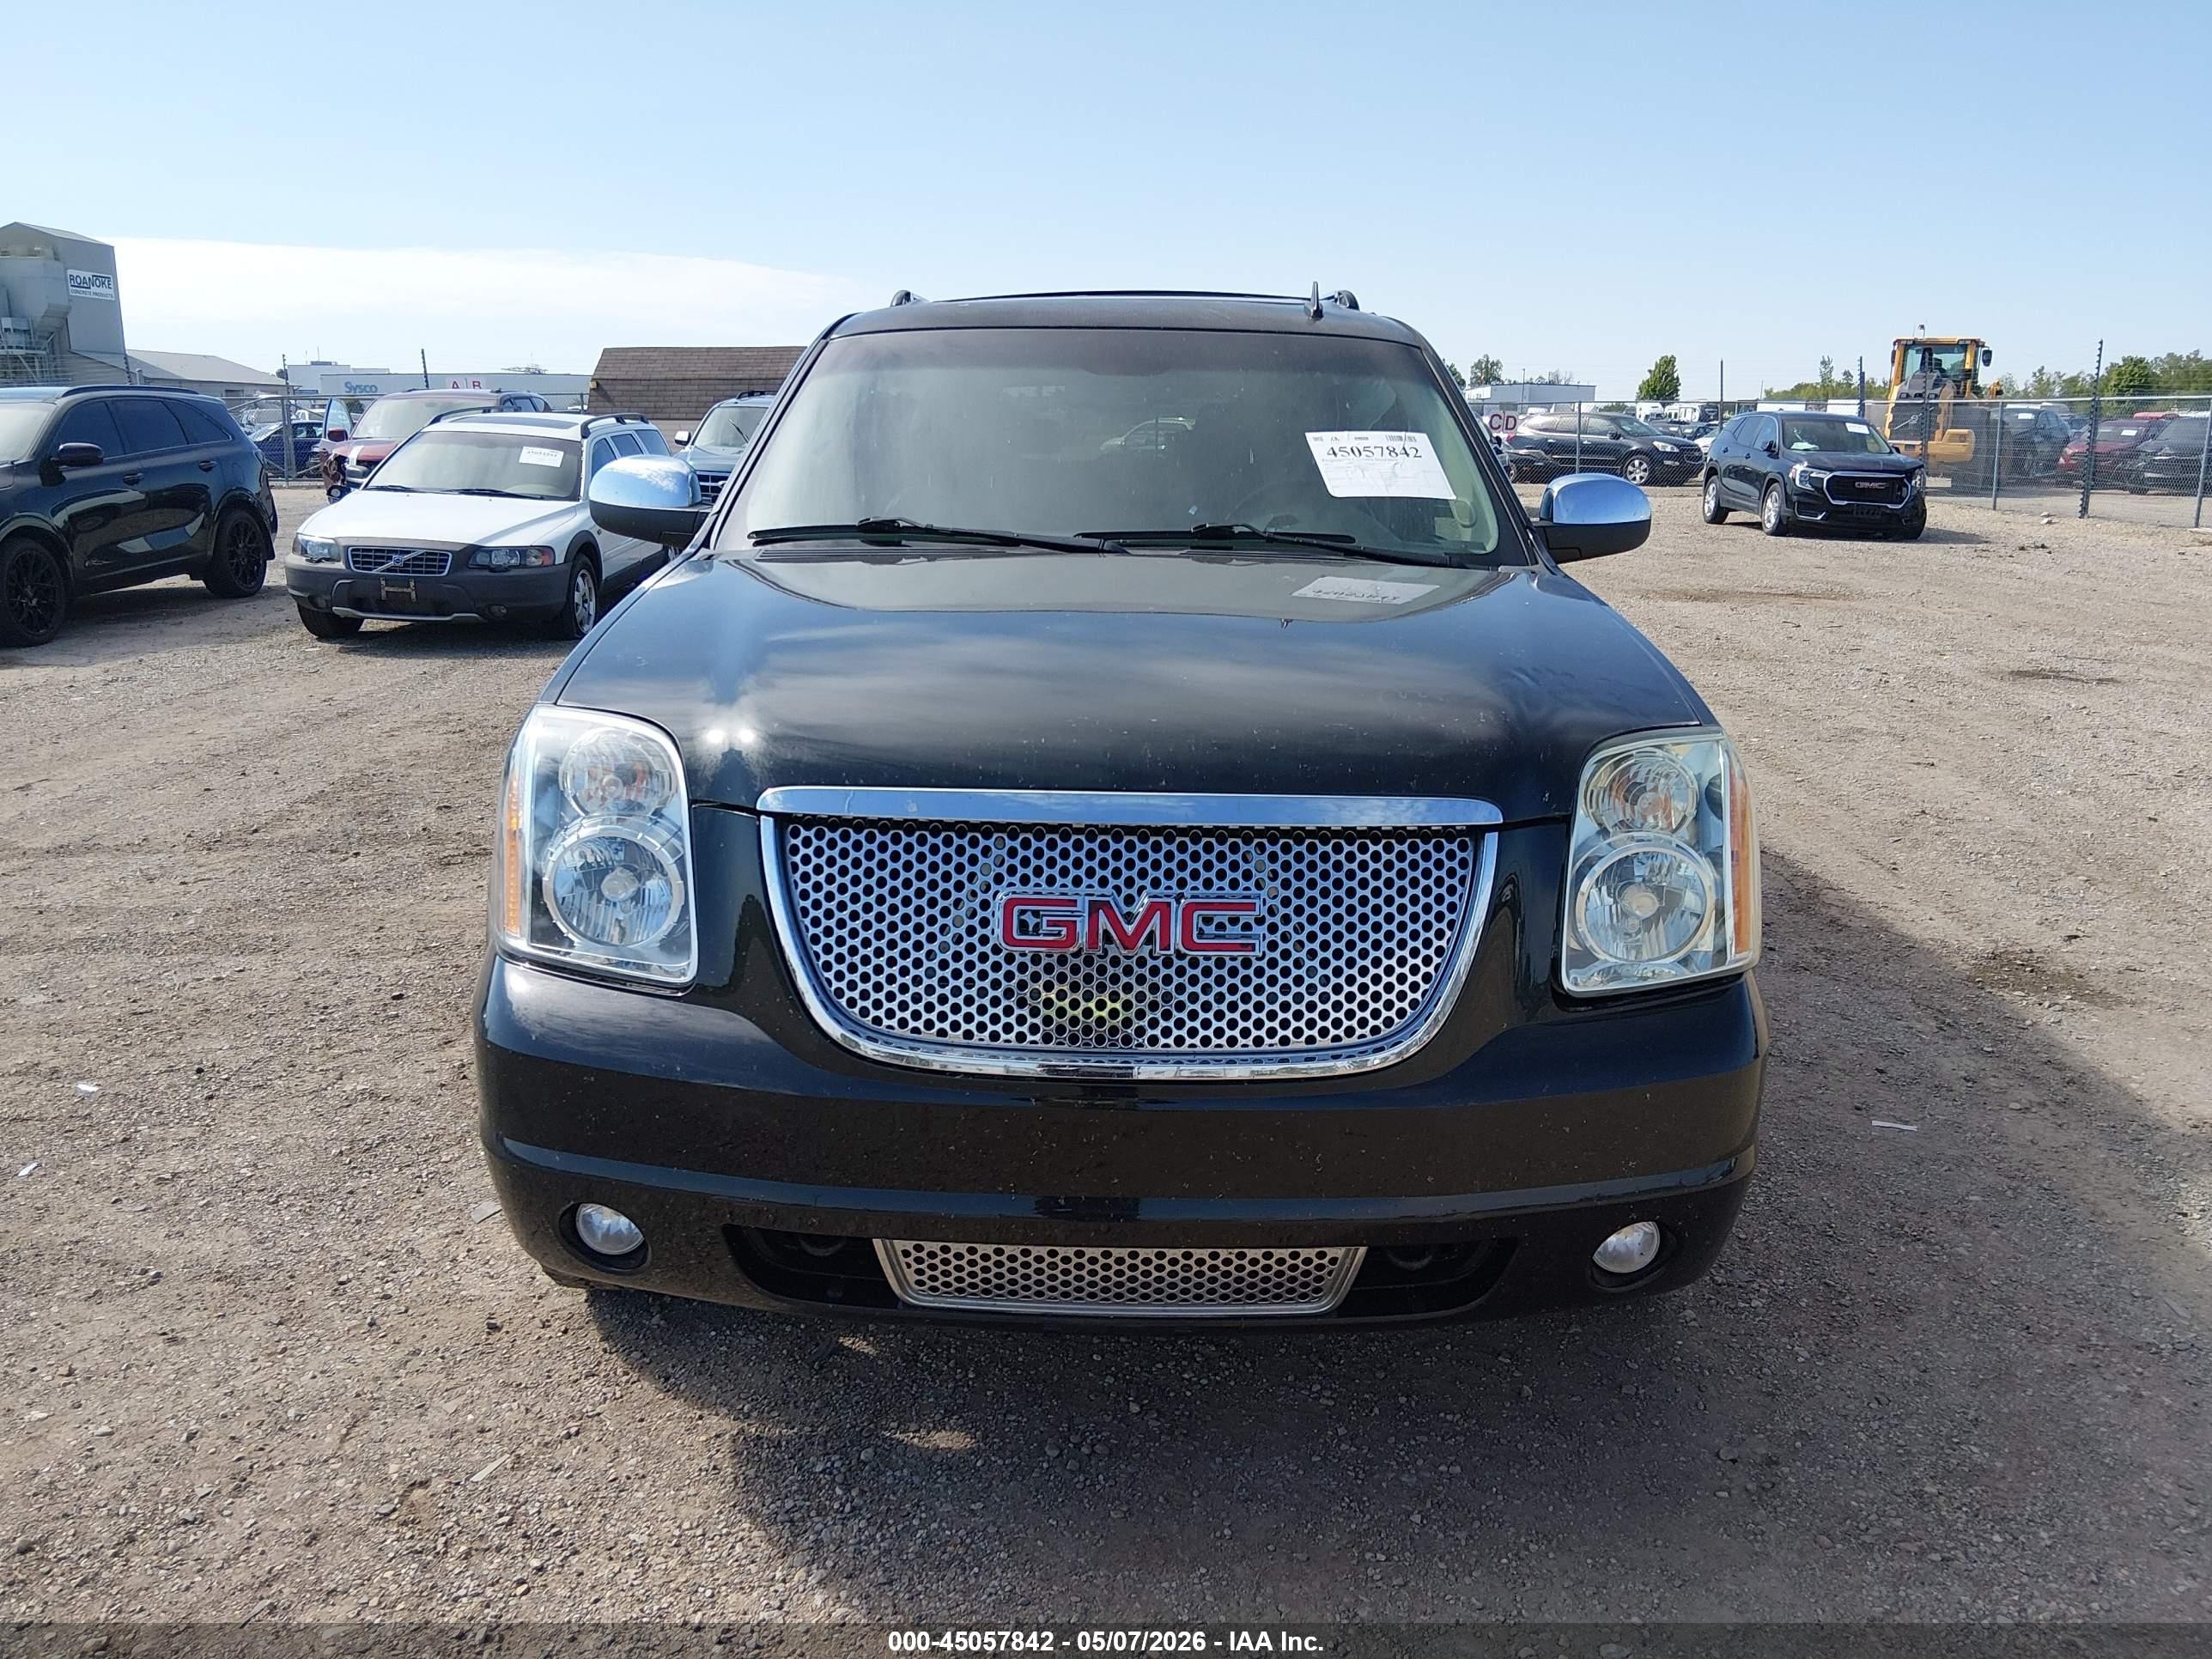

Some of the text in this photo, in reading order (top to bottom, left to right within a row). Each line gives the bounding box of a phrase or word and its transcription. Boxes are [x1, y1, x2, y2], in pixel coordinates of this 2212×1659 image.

[69, 274, 112, 289] ROANOKE
[344, 381, 378, 394] Sysco
[452, 380, 459, 389] A
[1488, 413, 1517, 430] C D
[1326, 441, 1423, 459] 45057842
[1855, 481, 1887, 489] GMC
[996, 890, 1264, 956] GMC
